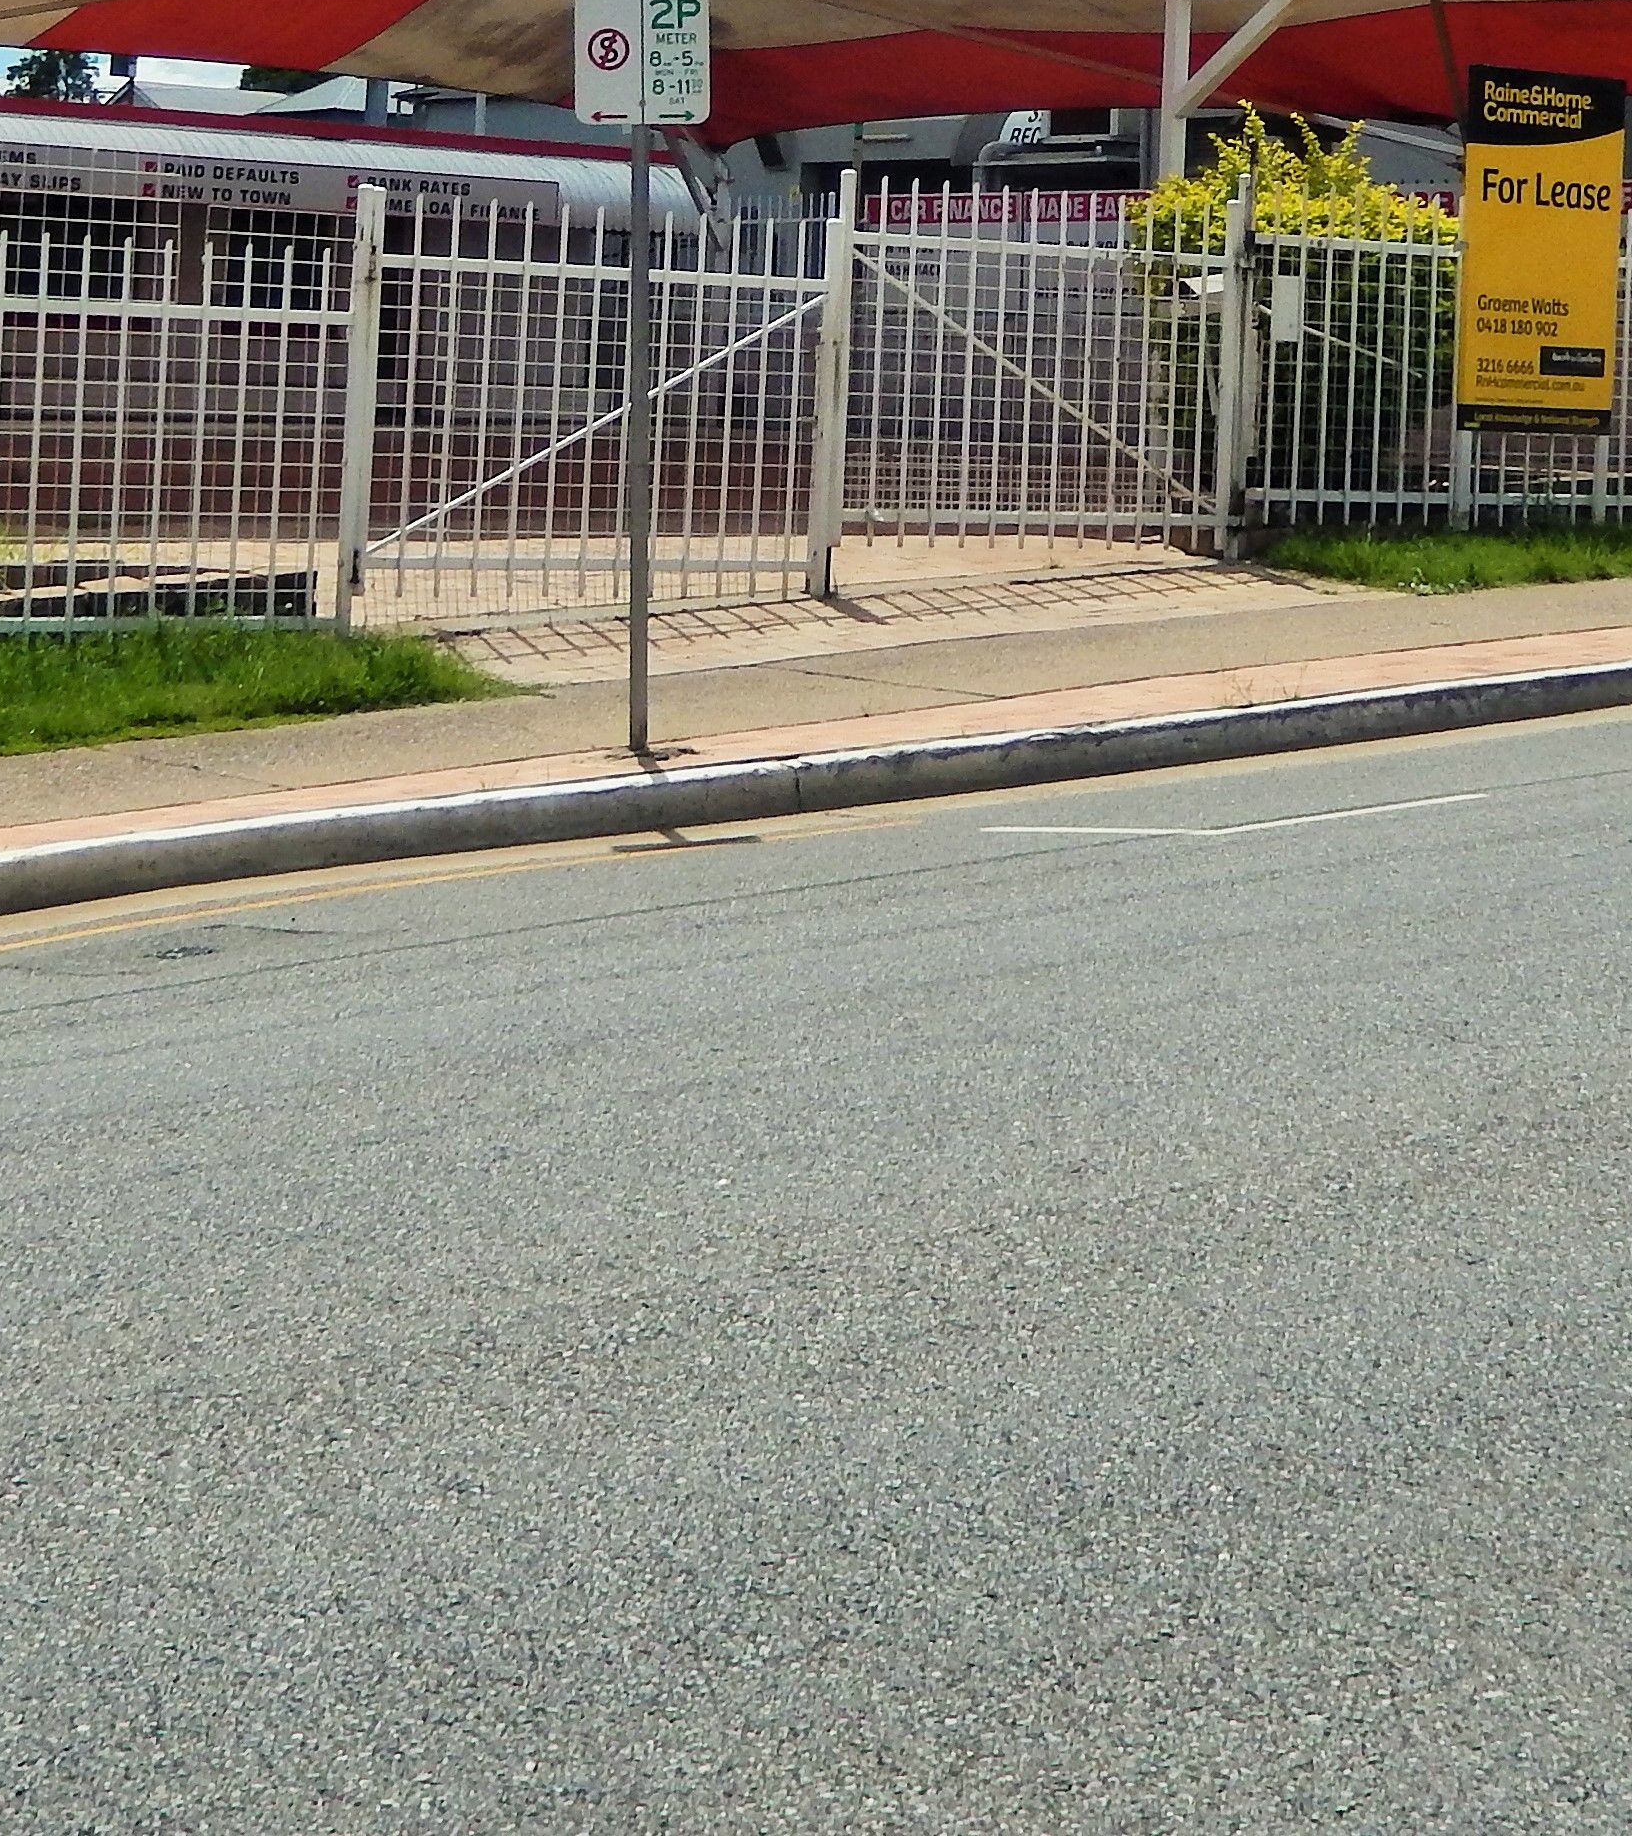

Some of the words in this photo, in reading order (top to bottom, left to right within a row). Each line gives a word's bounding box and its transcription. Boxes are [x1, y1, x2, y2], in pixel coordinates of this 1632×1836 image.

[655, 32, 697, 45] METER
[1483, 101, 1583, 130] Commercial
[212, 165, 300, 185] DEFAULTS
[162, 184, 205, 200] NEW
[211, 187, 232, 202] TO
[239, 189, 292, 205] TOWN
[419, 180, 471, 196] RATES
[1481, 167, 1529, 205] For
[1535, 172, 1612, 213] Lease
[890, 199, 927, 221] CAR
[933, 197, 1015, 220] FNANCE
[1477, 293, 1529, 314] Graeme
[1531, 297, 1570, 317] Watts
[1476, 316, 1508, 334] 0418
[1534, 321, 1559, 338] 902
